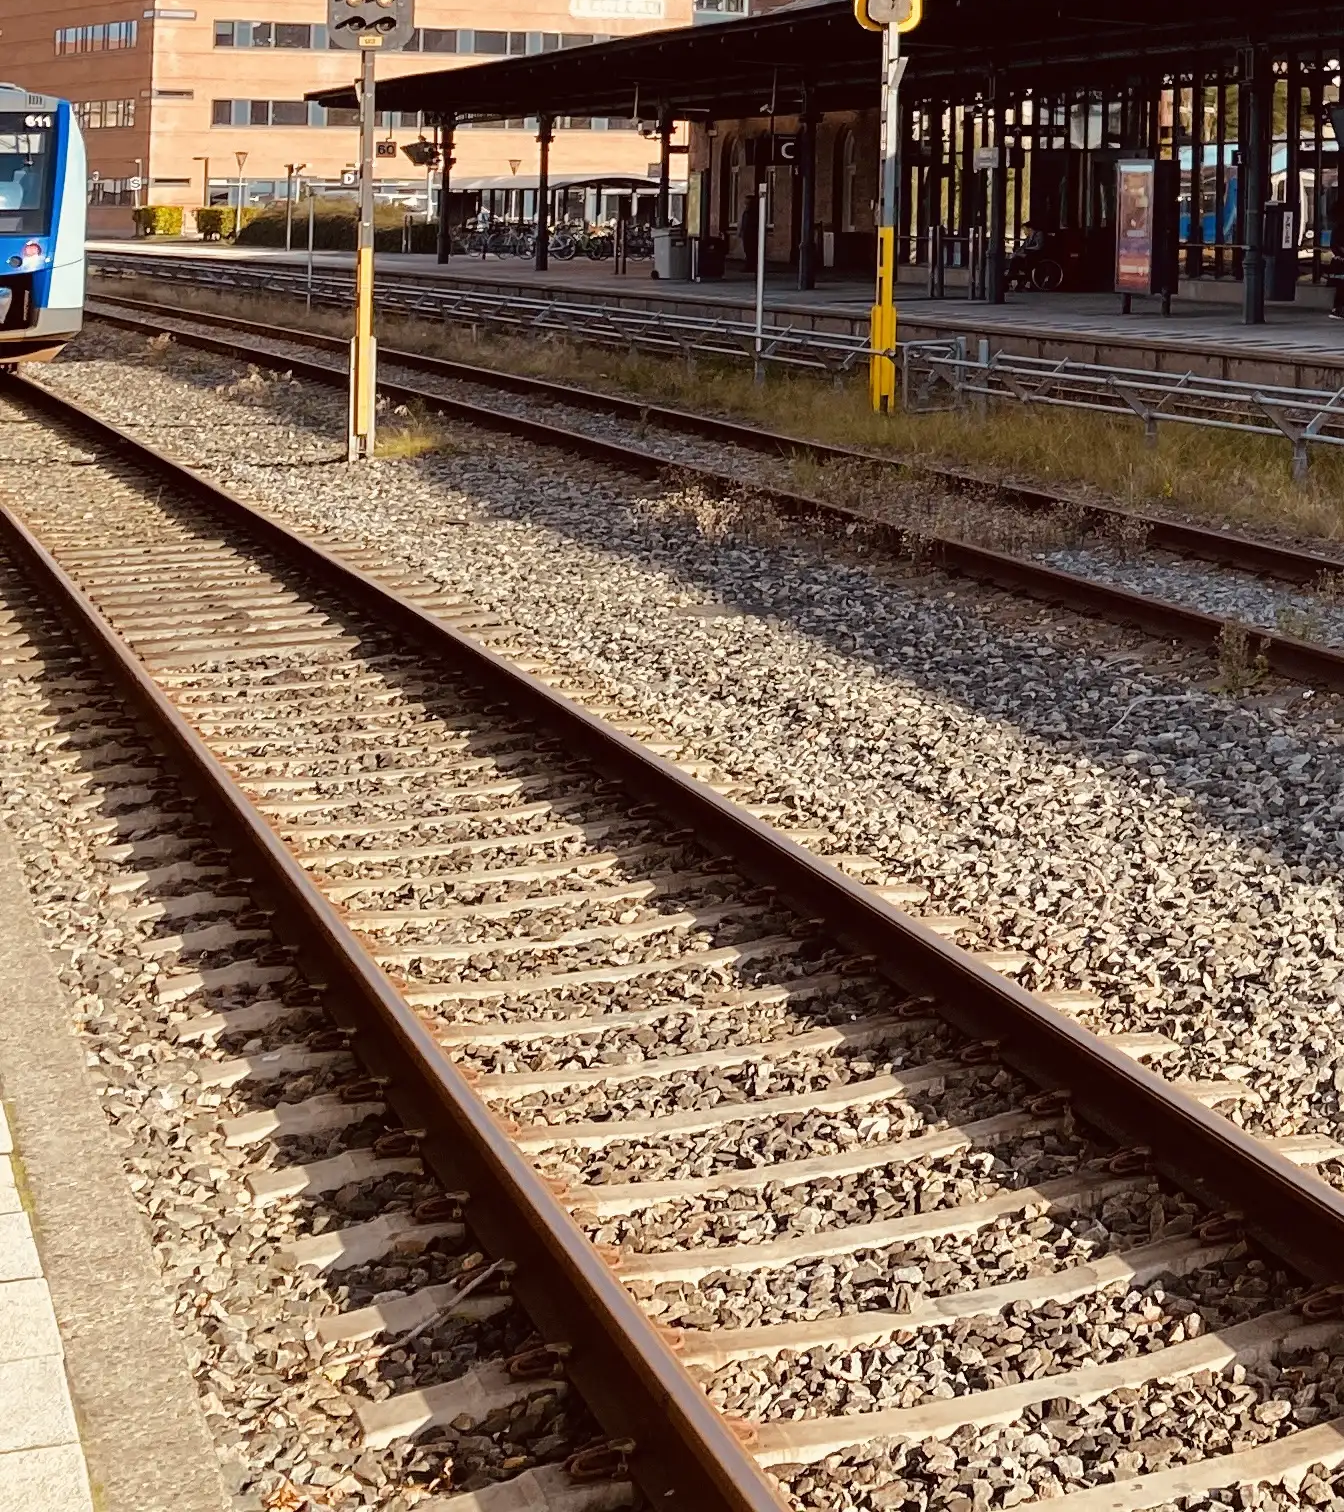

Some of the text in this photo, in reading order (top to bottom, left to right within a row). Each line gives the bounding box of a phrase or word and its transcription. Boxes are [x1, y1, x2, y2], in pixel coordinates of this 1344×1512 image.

[25, 115, 51, 128] 611
[377, 145, 395, 155] 60
[781, 142, 795, 159] C
